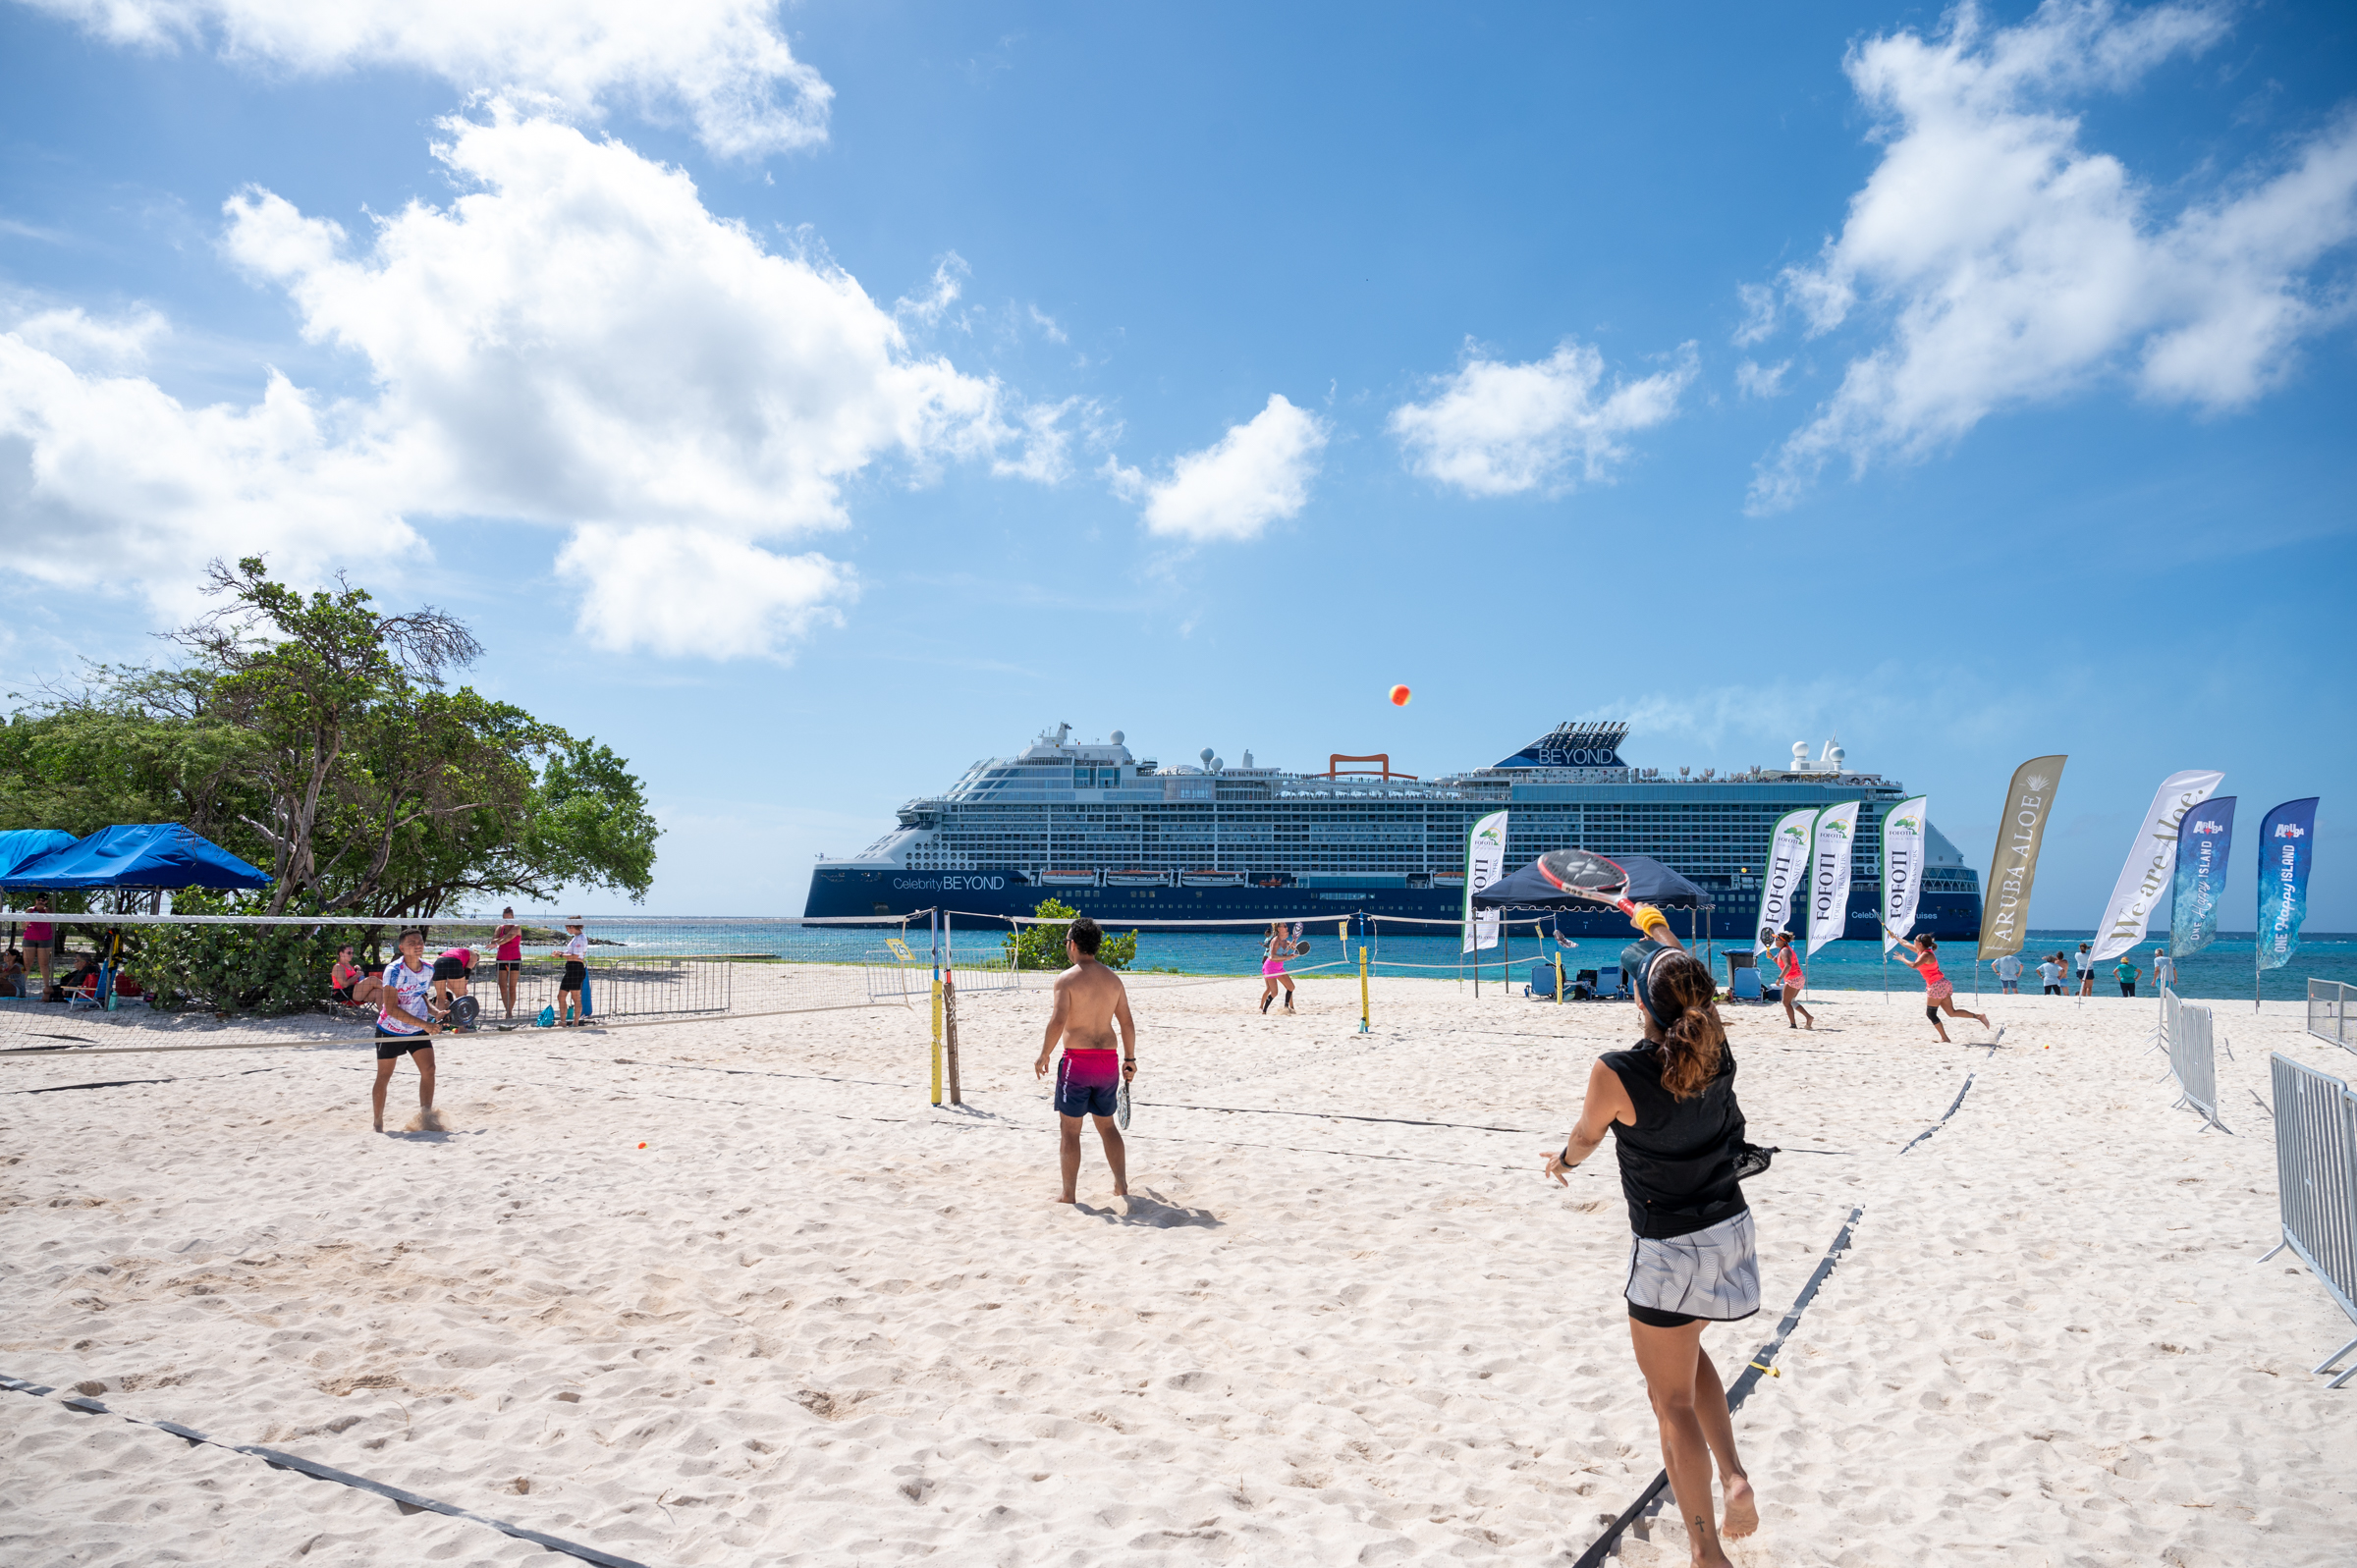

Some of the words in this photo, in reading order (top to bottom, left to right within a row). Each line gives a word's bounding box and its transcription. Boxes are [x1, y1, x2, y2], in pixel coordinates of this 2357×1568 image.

[1538, 748, 1614, 764] BEYOND
[2193, 820, 2223, 835] ARUBA
[2275, 823, 2305, 838] ARUBA
[1837, 853, 1846, 891] TRANSFERS
[1994, 865, 2026, 943] ARUBA
[2011, 794, 2042, 858] ALOE
[2198, 840, 2213, 878] ISLAND
[2280, 844, 2295, 882] ISLAND
[893, 877, 943, 892] Celebrity
[943, 876, 1005, 891] BEYOND
[1765, 856, 1790, 924] FOFOTI
[1817, 852, 1836, 921] FOFOTI
[1890, 850, 1907, 919] FOFOTI
[2109, 902, 2147, 941] We
[2140, 855, 2168, 897] are
[2191, 880, 2213, 920] Happy
[1834, 899, 1842, 921] TOURS
[2275, 883, 2296, 931] Happy
[2190, 922, 2203, 941] ONE
[2275, 934, 2288, 953] ONE
